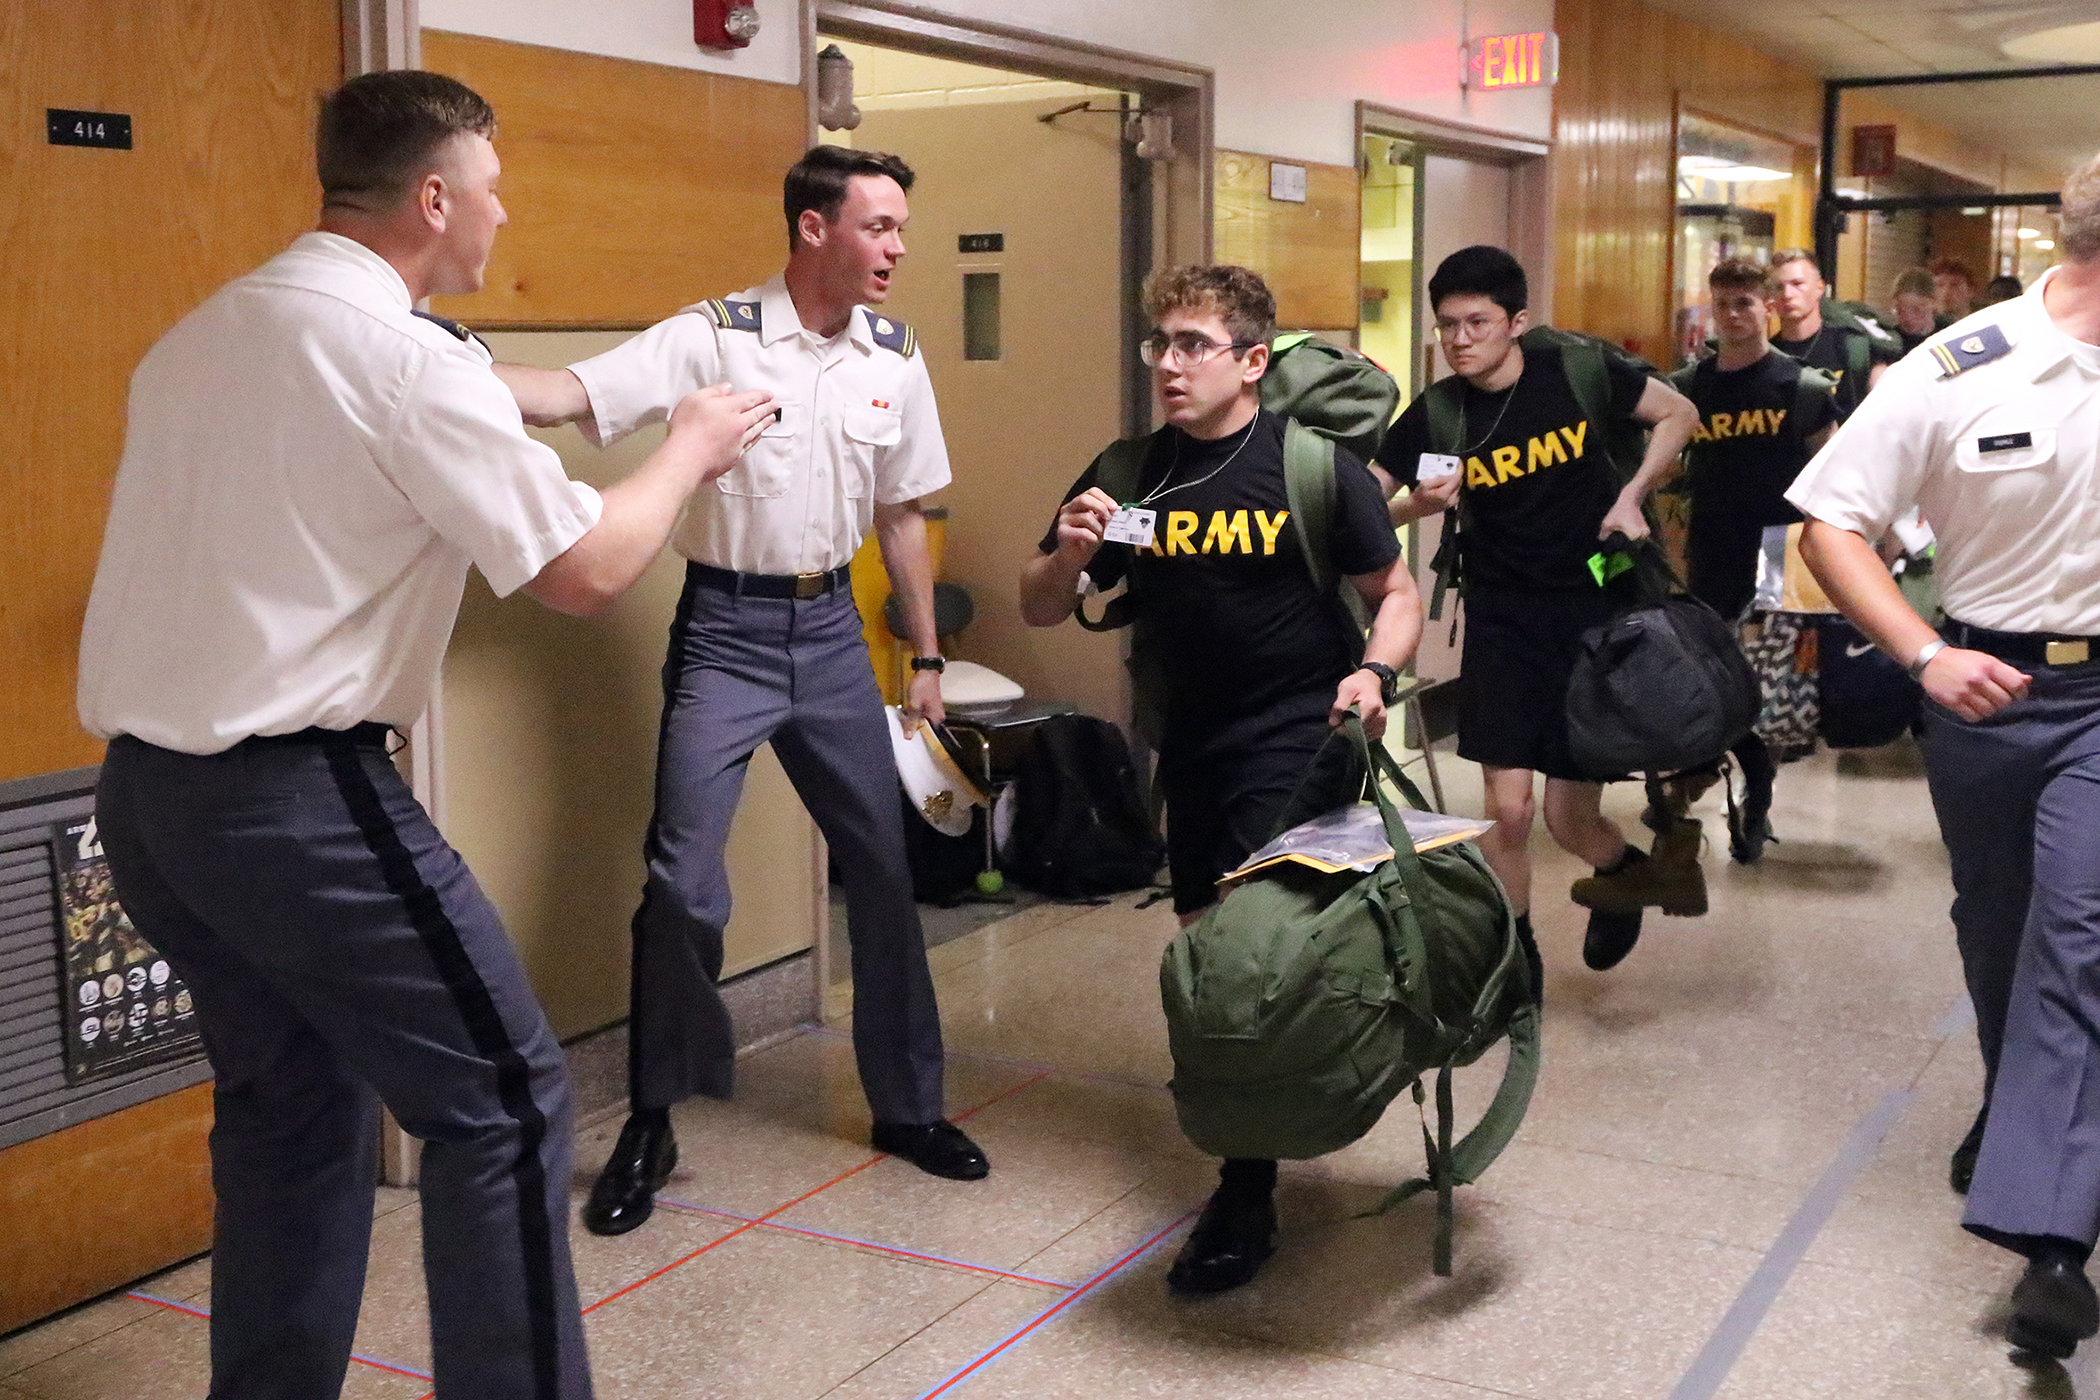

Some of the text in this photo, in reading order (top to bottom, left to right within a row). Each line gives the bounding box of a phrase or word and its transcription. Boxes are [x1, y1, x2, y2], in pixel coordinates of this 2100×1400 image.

[1482, 32, 1546, 89] EXIT
[74, 121, 105, 139] 414
[1466, 420, 1588, 489] ARMY
